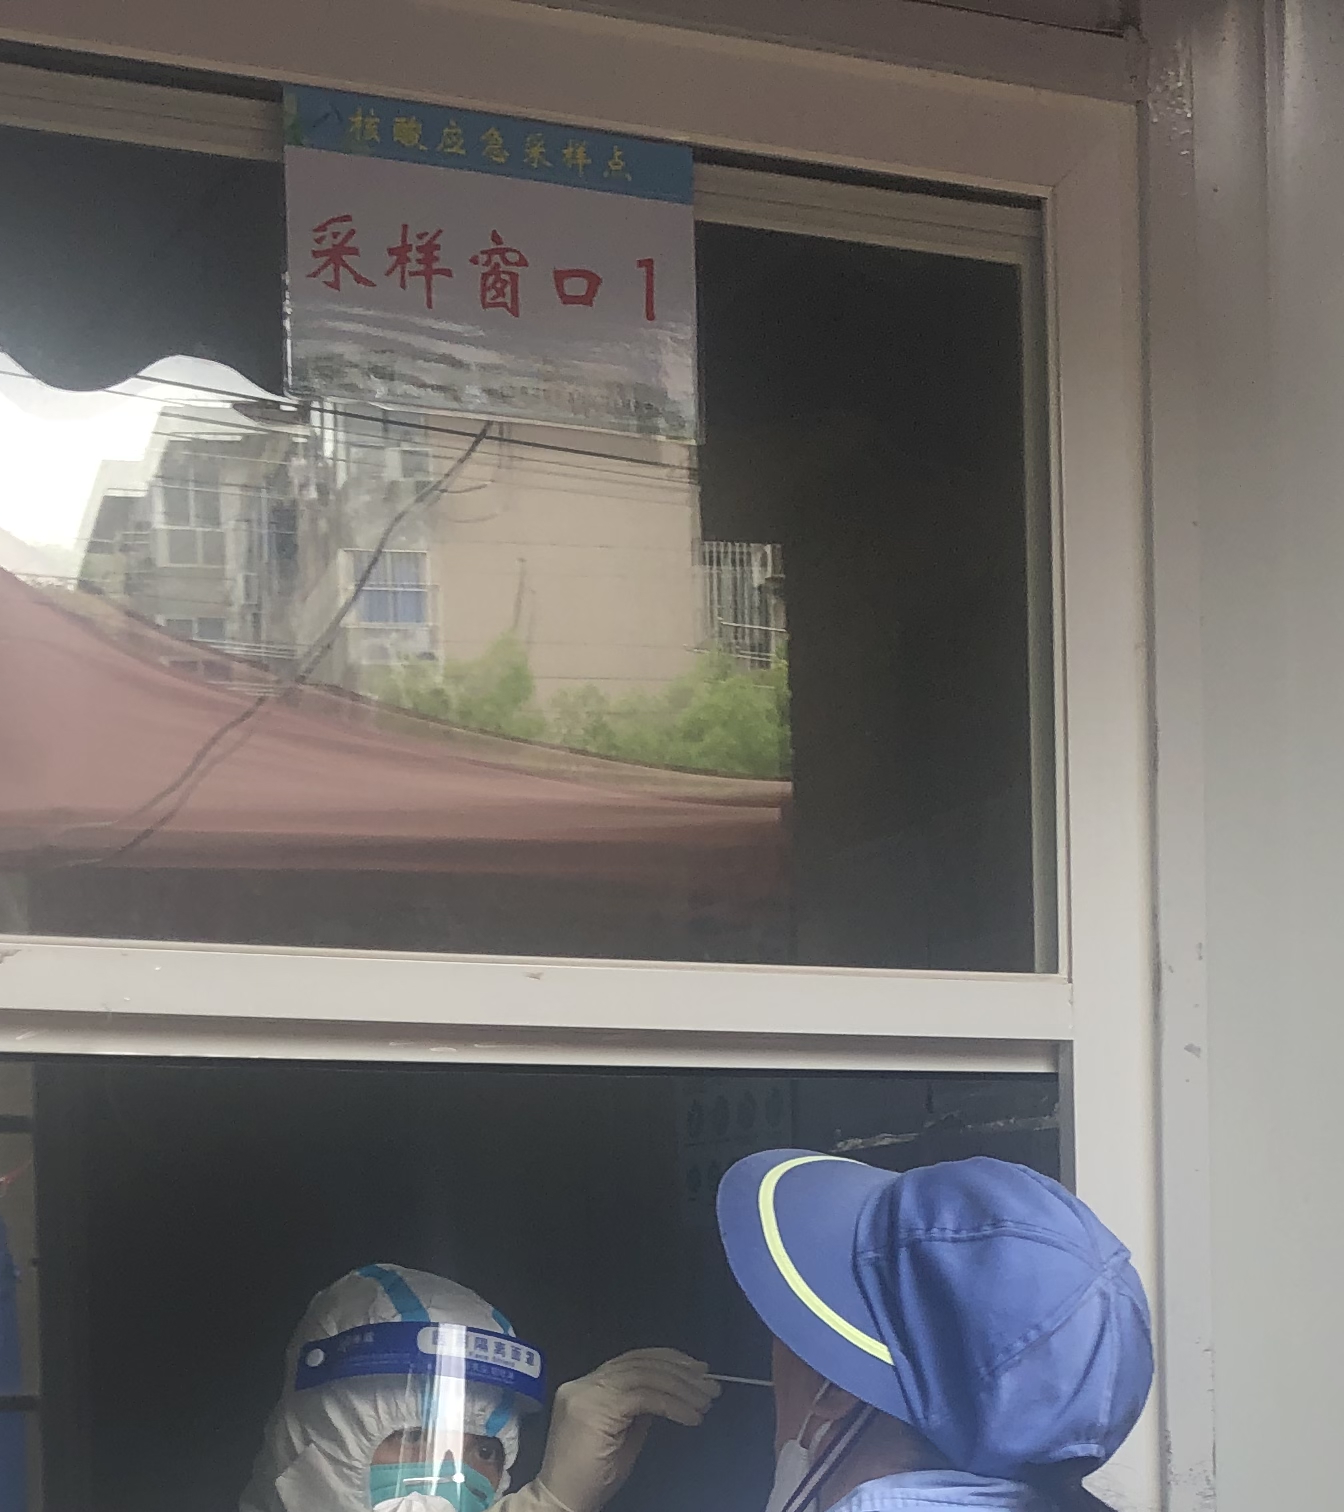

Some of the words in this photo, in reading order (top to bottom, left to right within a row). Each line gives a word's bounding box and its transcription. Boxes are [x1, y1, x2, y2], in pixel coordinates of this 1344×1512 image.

[348, 108, 632, 181] 核酸应急采样点
[306, 214, 656, 321] 采样窗口1
